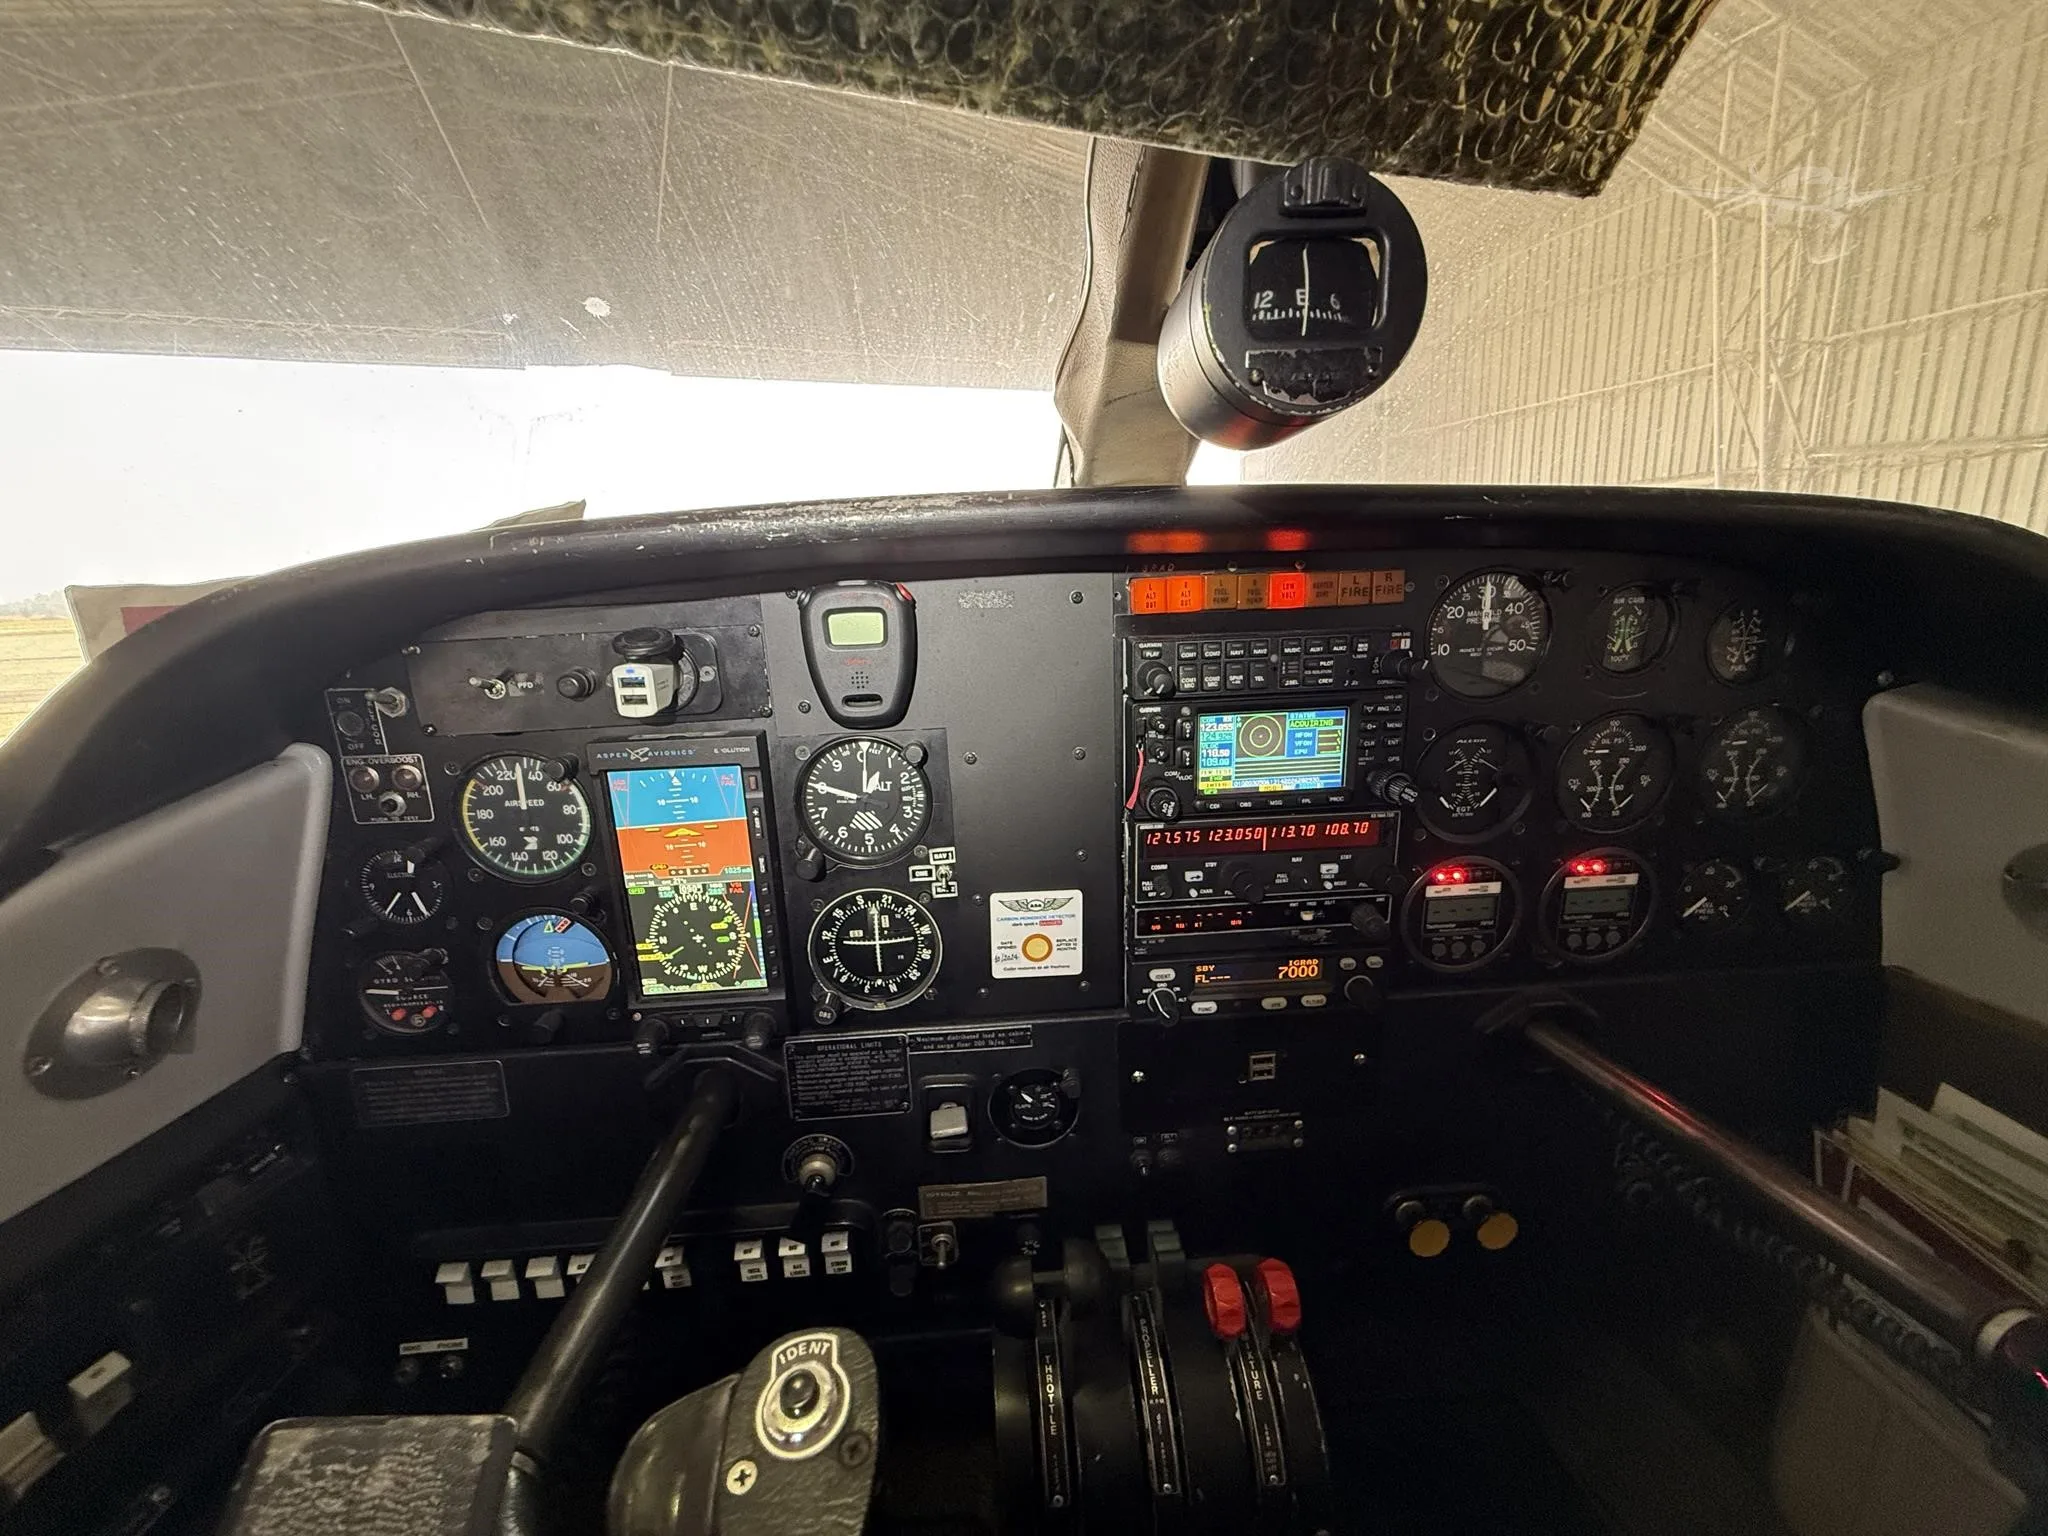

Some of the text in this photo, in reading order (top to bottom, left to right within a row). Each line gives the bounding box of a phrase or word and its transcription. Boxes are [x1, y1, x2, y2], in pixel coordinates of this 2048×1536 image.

[1253, 289, 1341, 310] 12 E 6
[1353, 576, 1359, 584] L
[1385, 572, 1393, 582] R
[1341, 587, 1369, 598] FIRE
[1375, 584, 1403, 595] FIRE
[1478, 586, 1496, 598] 30
[1462, 593, 1471, 601] 25
[1447, 606, 1464, 619] 20
[1505, 602, 1524, 614] 40
[1438, 644, 1449, 656] 10
[1508, 639, 1526, 652] 50
[648, 749, 693, 757] AVIONICS
[368, 756, 418, 764] OVERBOOST
[888, 757, 893, 769] 1
[832, 760, 842, 772] 9
[528, 771, 543, 781] 40
[900, 772, 911, 784] 2
[483, 785, 504, 796] 200
[547, 782, 561, 792] 60
[818, 782, 827, 794] 8
[874, 781, 892, 791] ALT
[505, 799, 545, 807] AIREED
[476, 809, 494, 819] 180
[563, 805, 577, 815] 80
[818, 807, 828, 819] 7
[903, 807, 912, 818] 3
[838, 827, 848, 838] 6
[889, 823, 900, 833] 4
[489, 836, 507, 847] 160
[556, 834, 573, 844] 100
[865, 833, 875, 845] 5
[511, 852, 528, 861] 140
[542, 850, 558, 860] 120
[856, 895, 865, 905] S
[882, 894, 892, 903] 21
[832, 908, 844, 919] 15
[904, 905, 917, 915] 24
[919, 924, 932, 935] W
[659, 936, 667, 944] N
[822, 930, 832, 941] 12
[921, 948, 932, 960] 30
[822, 956, 833, 964] E
[1288, 958, 1319, 966] IGRAD
[697, 965, 708, 973] W
[1196, 964, 1216, 972] SBY
[1278, 965, 1318, 979] 7000
[839, 975, 848, 983] 6
[908, 969, 921, 980] 33
[888, 983, 898, 993] N
[948, 1033, 979, 1041] distributed
[817, 1041, 882, 1051] OPERATIONAL LIMITS
[778, 1341, 830, 1365] IDENT
[1139, 1318, 1159, 1396] PROPELLER
[1241, 1333, 1263, 1401] IXTURE
[1044, 1354, 1058, 1437] THROTTLE
